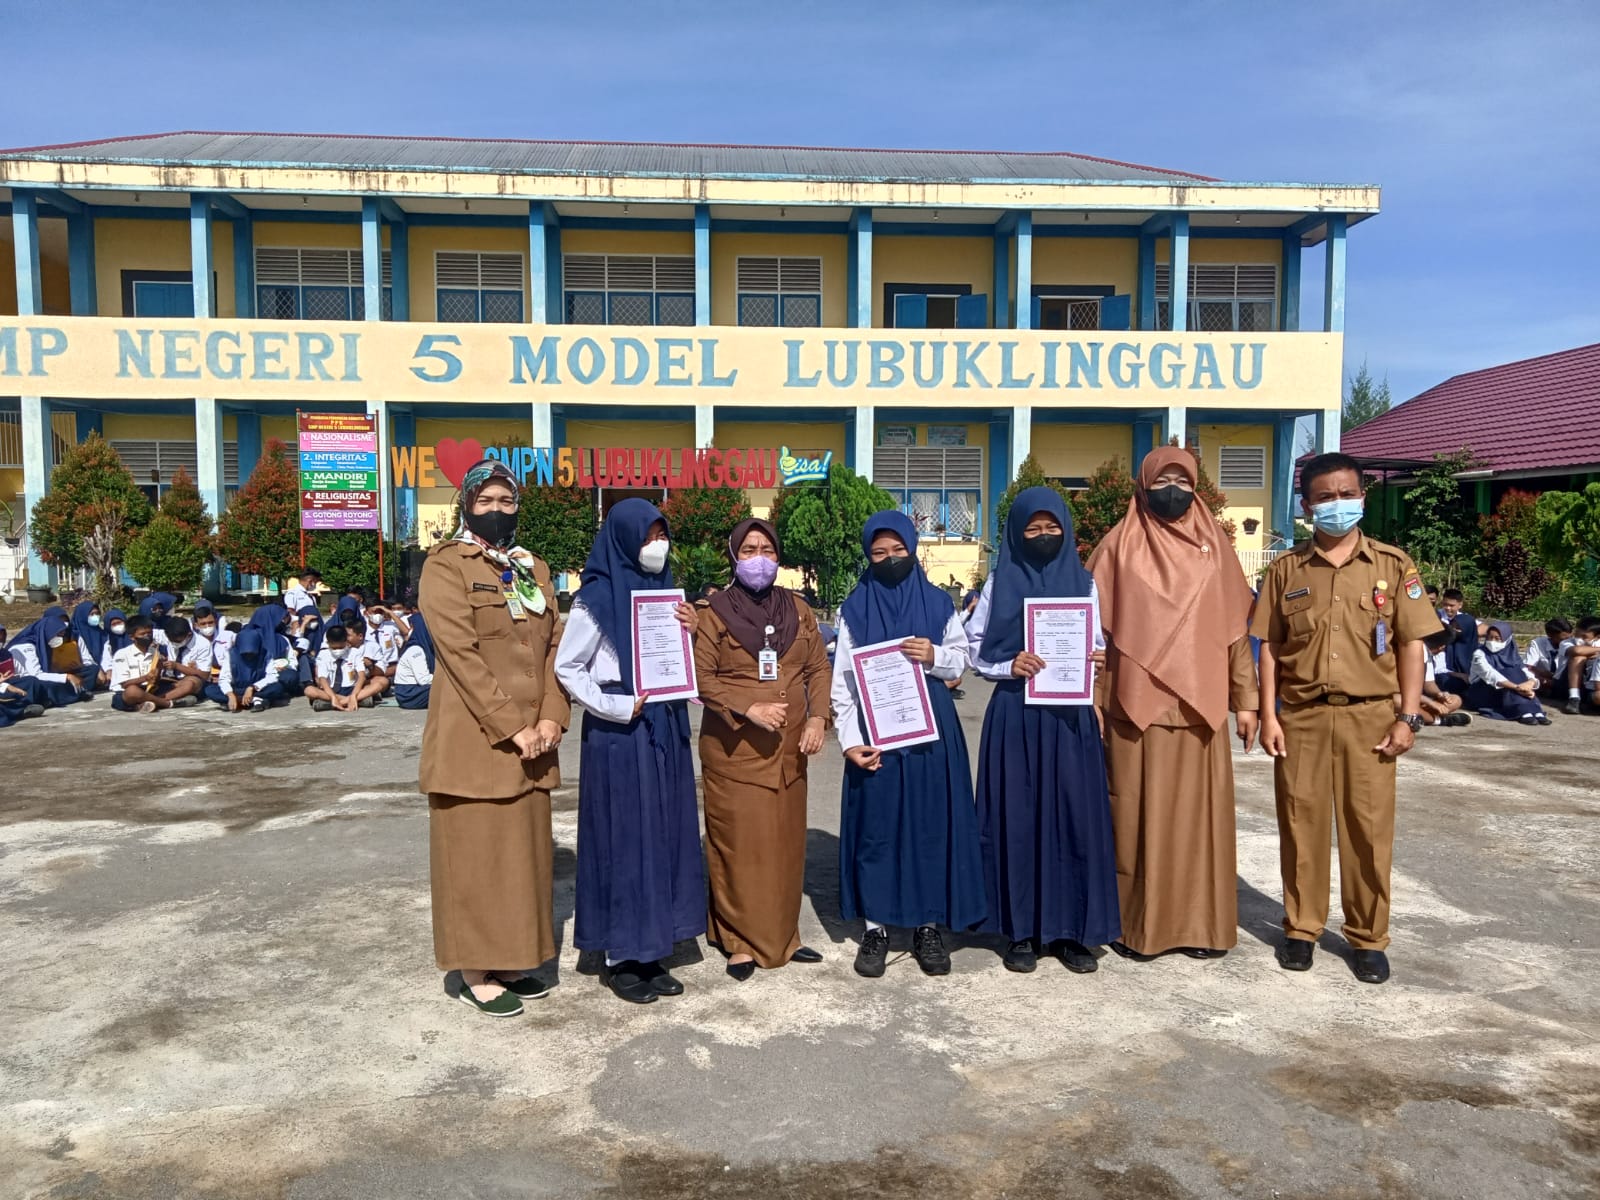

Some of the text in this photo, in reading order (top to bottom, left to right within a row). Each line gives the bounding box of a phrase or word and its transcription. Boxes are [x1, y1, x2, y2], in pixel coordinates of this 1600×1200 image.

[114, 328, 362, 382] NEGERI
[410, 333, 463, 384] 5
[510, 335, 737, 388] MODEL
[784, 339, 1267, 391] LUBUKLINGGAU
[310, 433, 373, 441] NASIONALISME
[391, 446, 436, 488] WE
[558, 447, 575, 488] 5
[577, 447, 776, 489] LUBUKLINGGAU
[303, 472, 368, 480] 3. MANDIRI
[315, 492, 371, 500] RELIGIUSITAS
